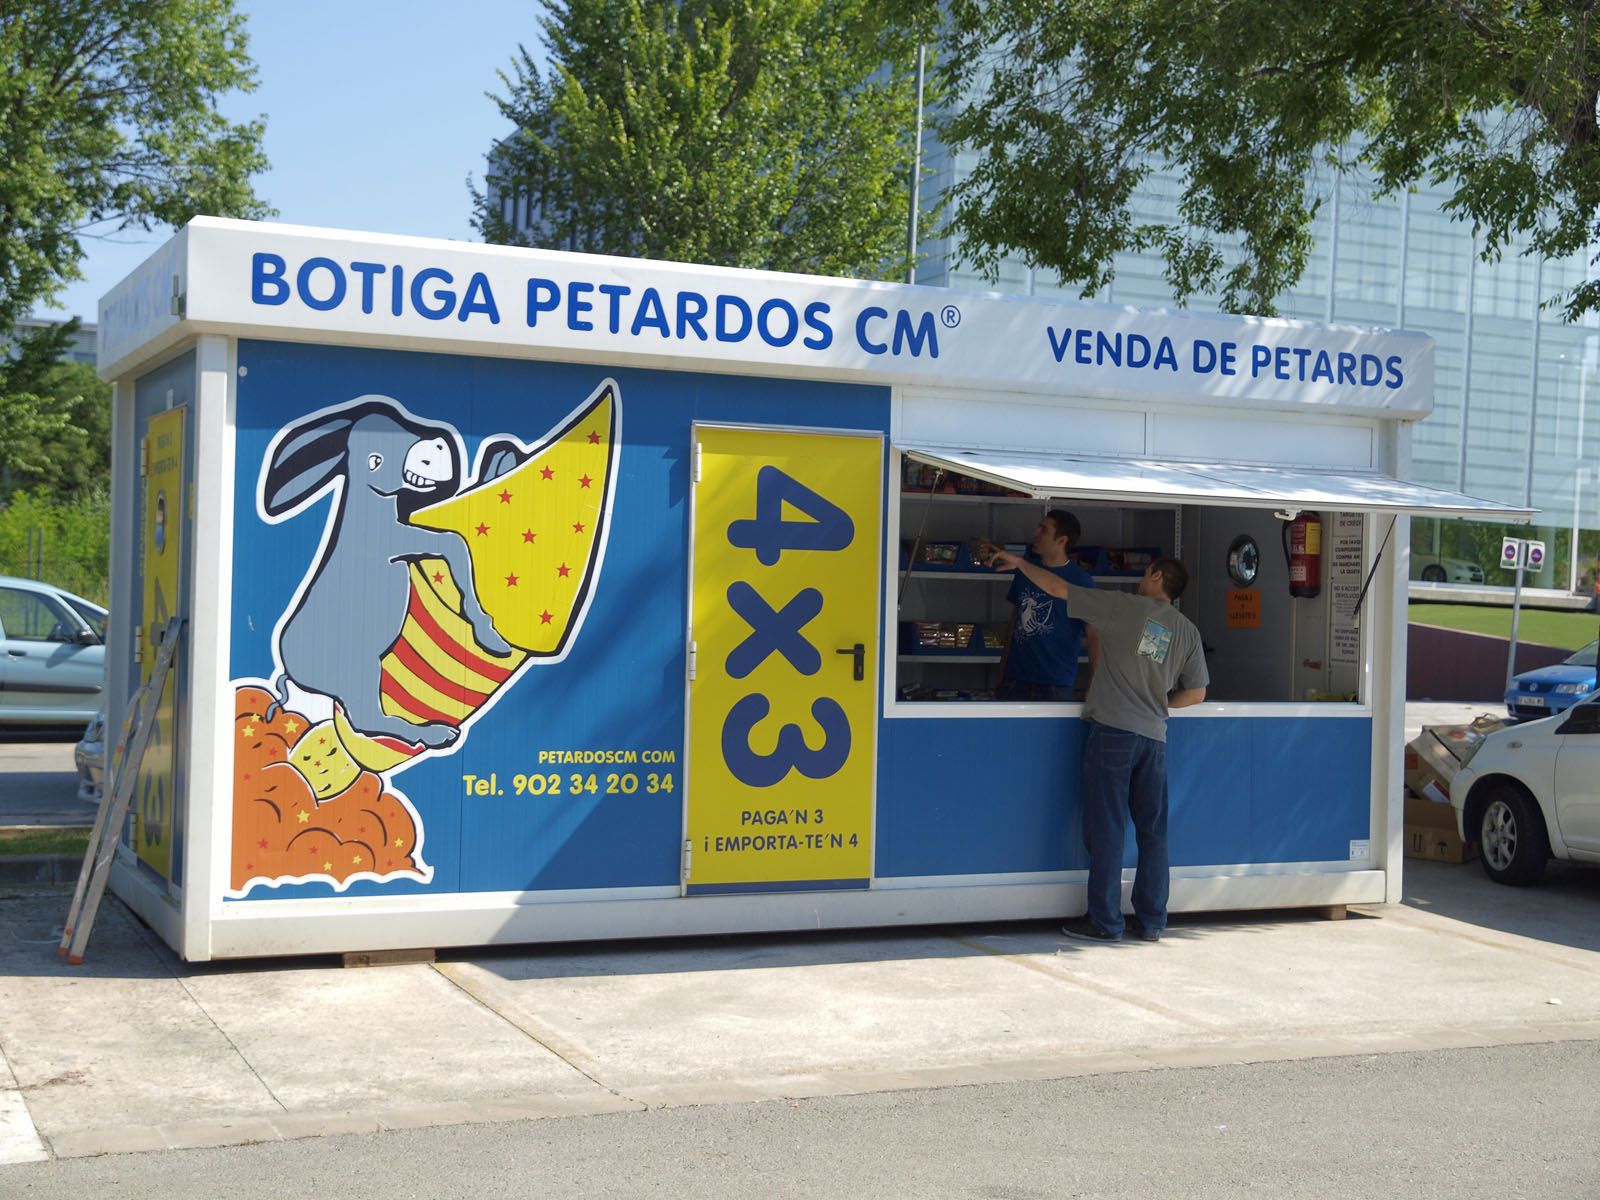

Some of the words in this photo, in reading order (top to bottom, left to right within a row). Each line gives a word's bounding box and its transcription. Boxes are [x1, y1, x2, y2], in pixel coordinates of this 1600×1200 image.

[250, 251, 502, 326] BOTIGA
[526, 277, 834, 352] PETARDOS
[1044, 324, 1181, 375] VENDA
[1189, 338, 1240, 378] DE
[1250, 343, 1405, 391] PETARDS
[538, 750, 638, 764] PETARDOSCM
[641, 750, 676, 764] COM
[463, 773, 504, 797] Tel.
[512, 773, 562, 796] 902
[569, 773, 599, 796] 34
[606, 773, 640, 795] 20
[646, 773, 675, 795] 34
[814, 809, 825, 825] 3
[848, 834, 860, 849] 4
